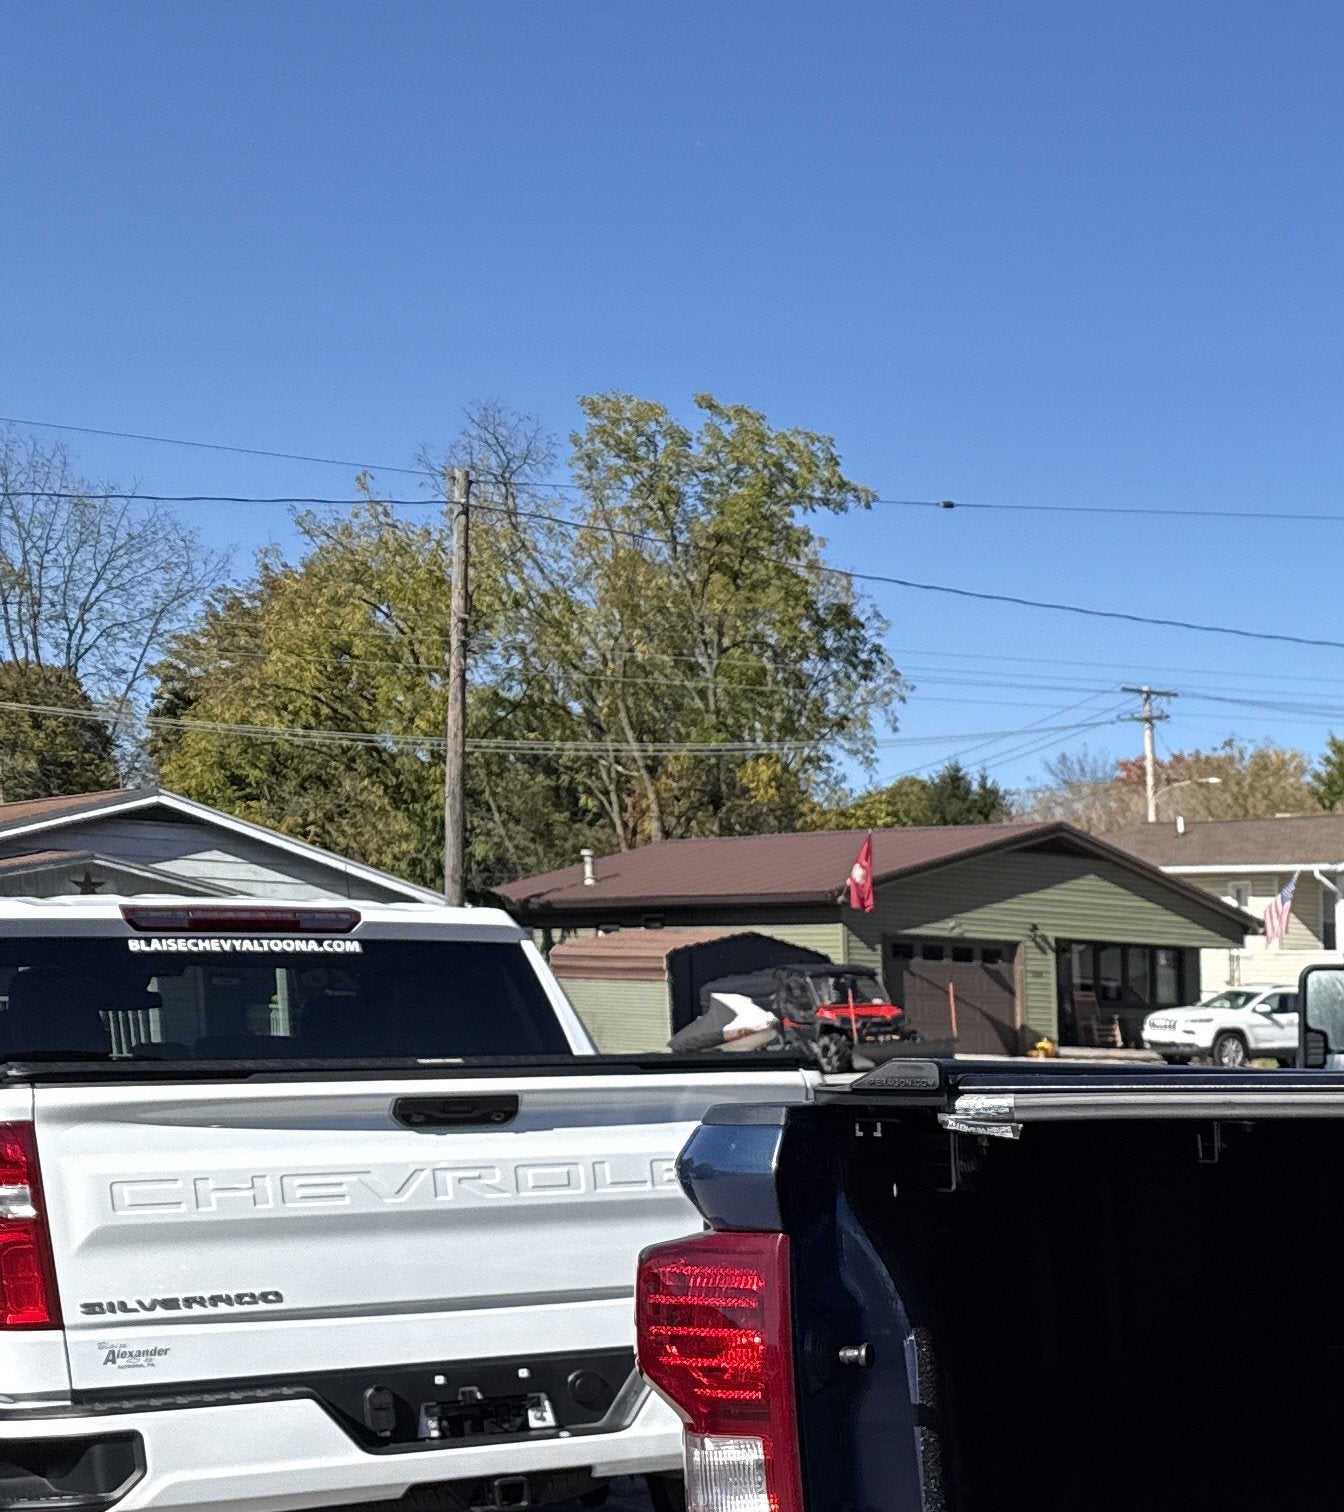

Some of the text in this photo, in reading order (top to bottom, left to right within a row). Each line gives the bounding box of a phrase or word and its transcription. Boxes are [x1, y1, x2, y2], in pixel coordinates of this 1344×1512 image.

[128, 939, 362, 952] BLAISECHEVYALTOONA.COM
[79, 1290, 285, 1316] SILVERADO
[102, 1346, 171, 1366] Alexander
